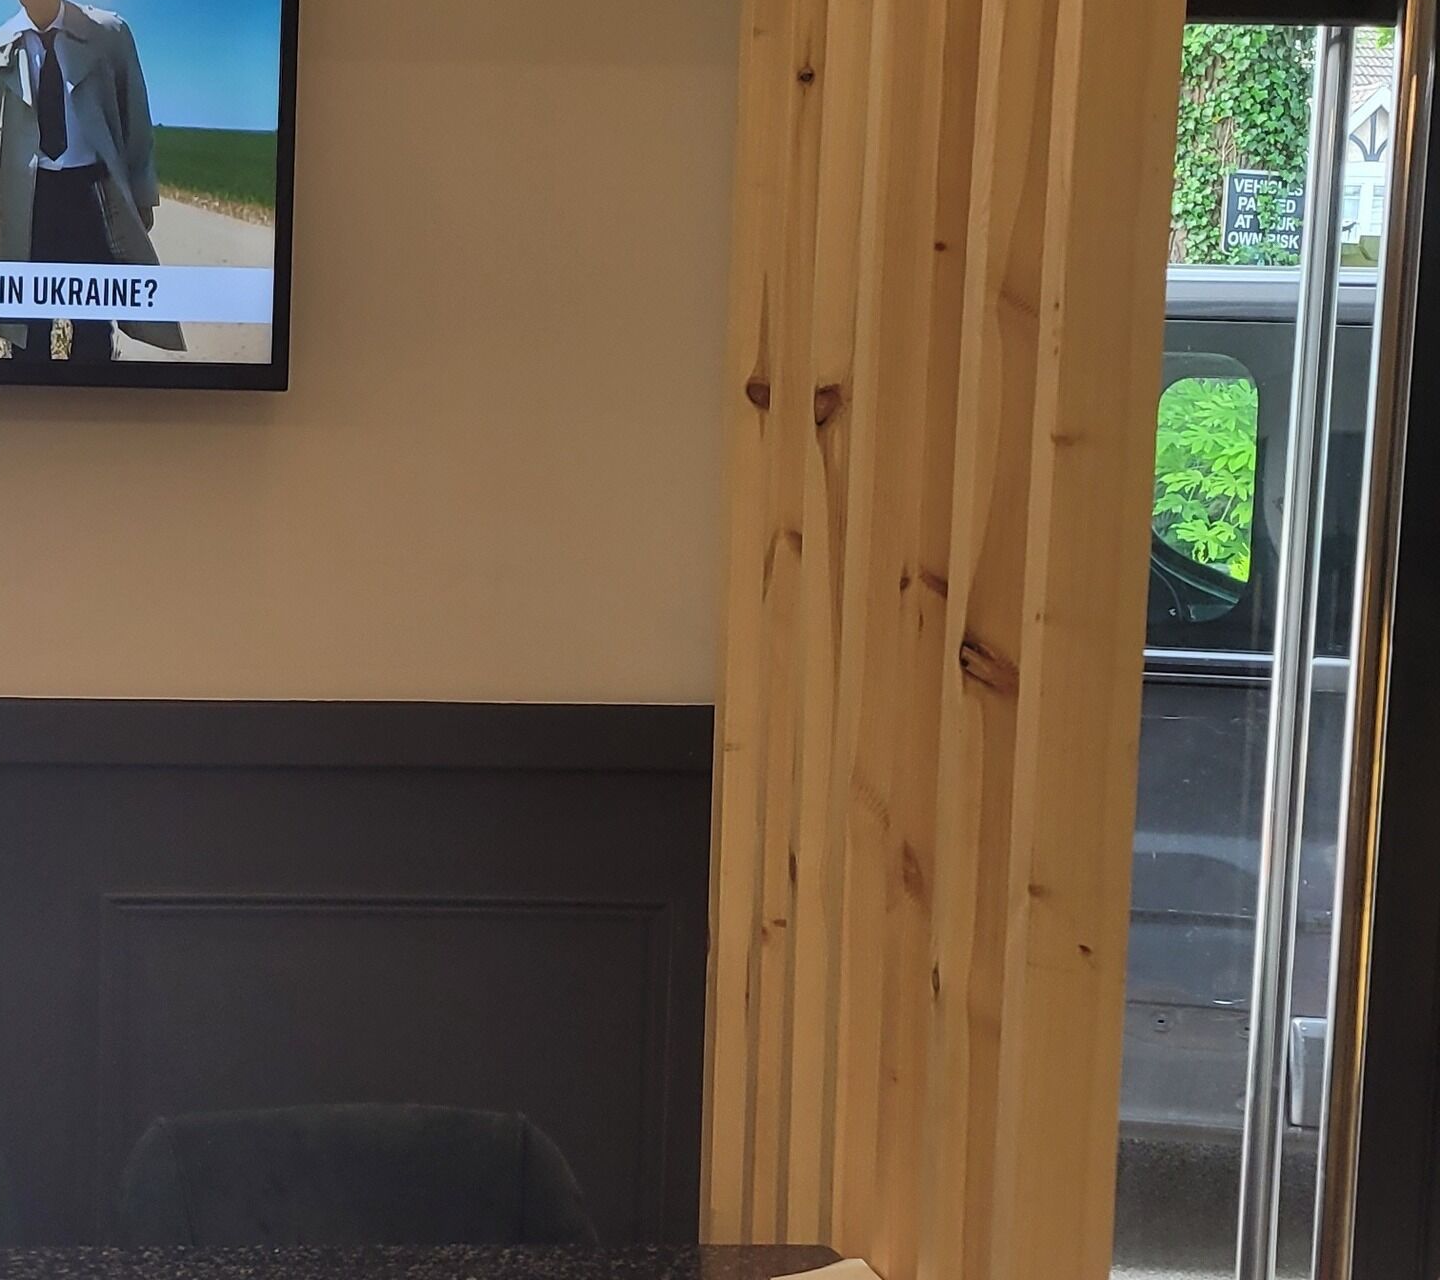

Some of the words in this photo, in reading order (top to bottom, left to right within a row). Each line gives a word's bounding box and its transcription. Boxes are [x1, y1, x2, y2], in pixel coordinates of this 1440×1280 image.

[1237, 196, 1297, 213] PAED
[1233, 214, 1254, 229] AT
[1227, 231, 1263, 247] OWN
[0, 275, 24, 305] IN
[33, 276, 159, 308] UKRAINE?
